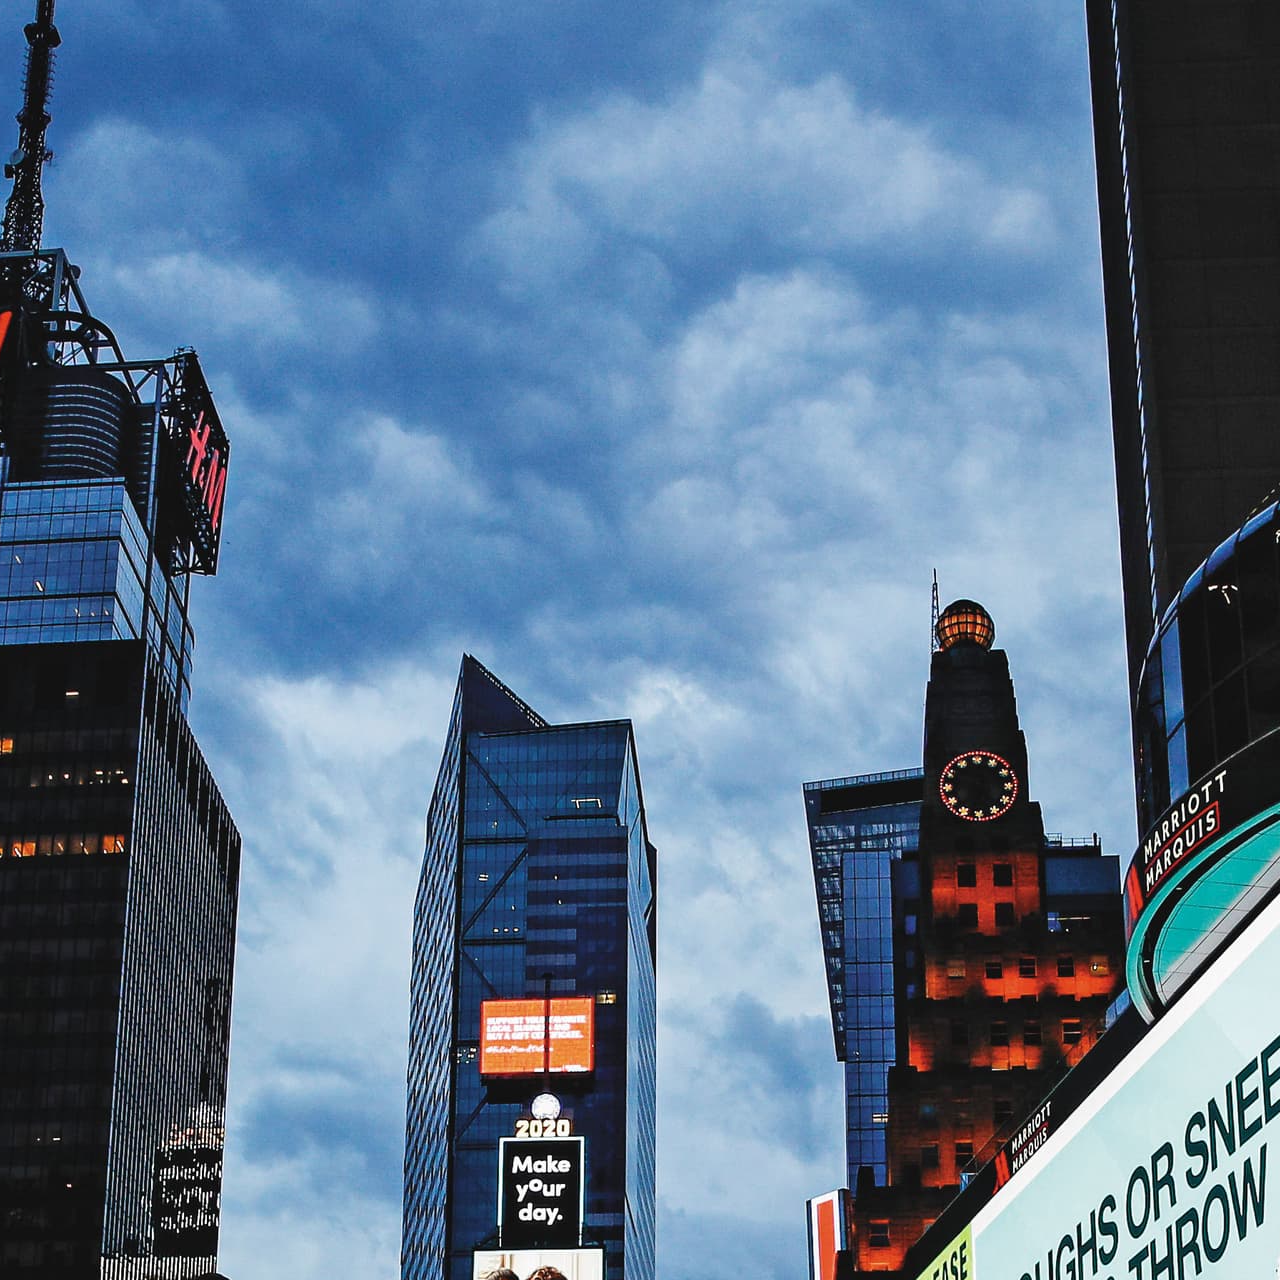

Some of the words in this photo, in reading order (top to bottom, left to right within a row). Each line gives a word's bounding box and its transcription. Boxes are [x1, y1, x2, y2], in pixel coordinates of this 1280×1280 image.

[1144, 769, 1227, 864] MARRIOTT
[1145, 810, 1216, 892] MARQUIS
[515, 1119, 570, 1138] 2020
[1011, 1101, 1052, 1154] MARRIOTT
[1012, 1127, 1048, 1174] MARQUIS
[512, 1156, 571, 1174] Make
[516, 1177, 566, 1203] your
[1126, 1142, 1175, 1238] OR
[518, 1203, 564, 1227] day.
